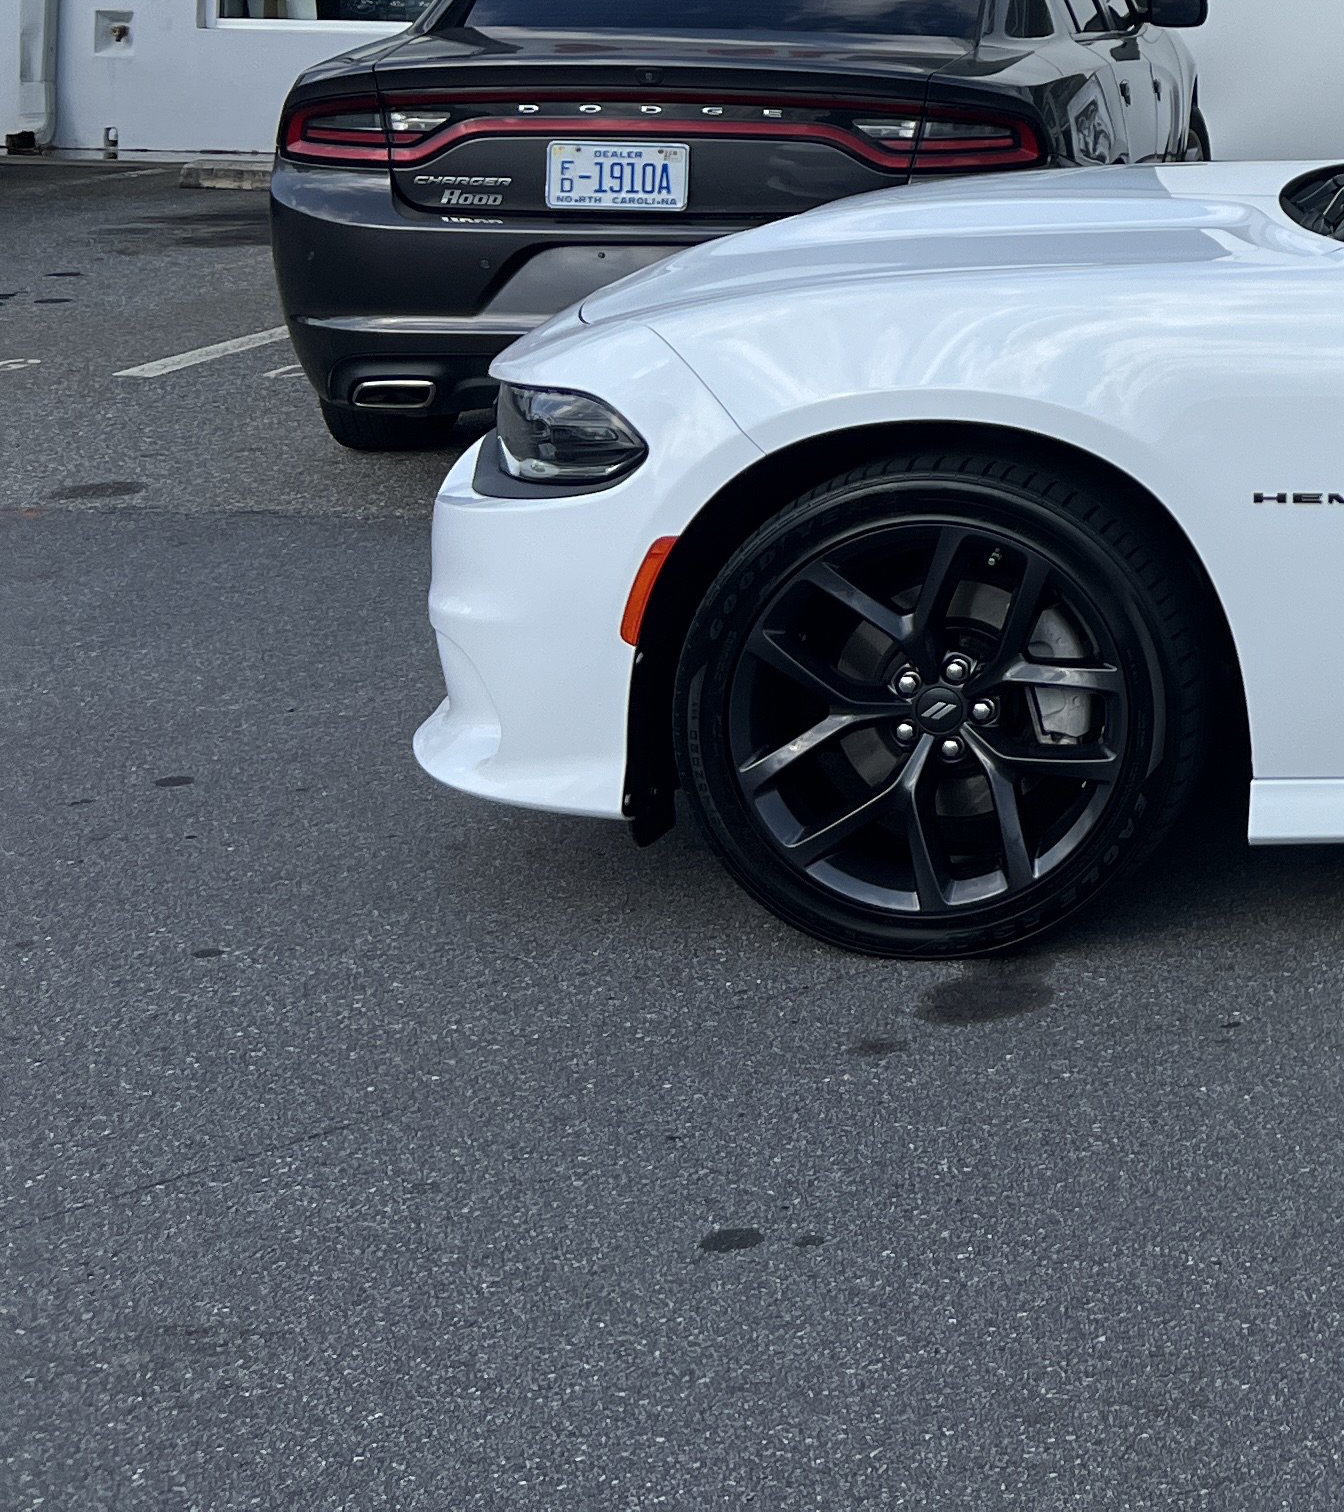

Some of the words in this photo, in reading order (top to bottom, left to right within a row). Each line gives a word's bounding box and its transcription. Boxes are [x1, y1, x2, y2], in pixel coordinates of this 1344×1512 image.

[517, 103, 784, 118] DODGE
[593, 149, 643, 159] DEALER
[412, 175, 513, 187] CHARGER
[555, 195, 602, 204] NORTH
[611, 196, 678, 206] CAROLINA
